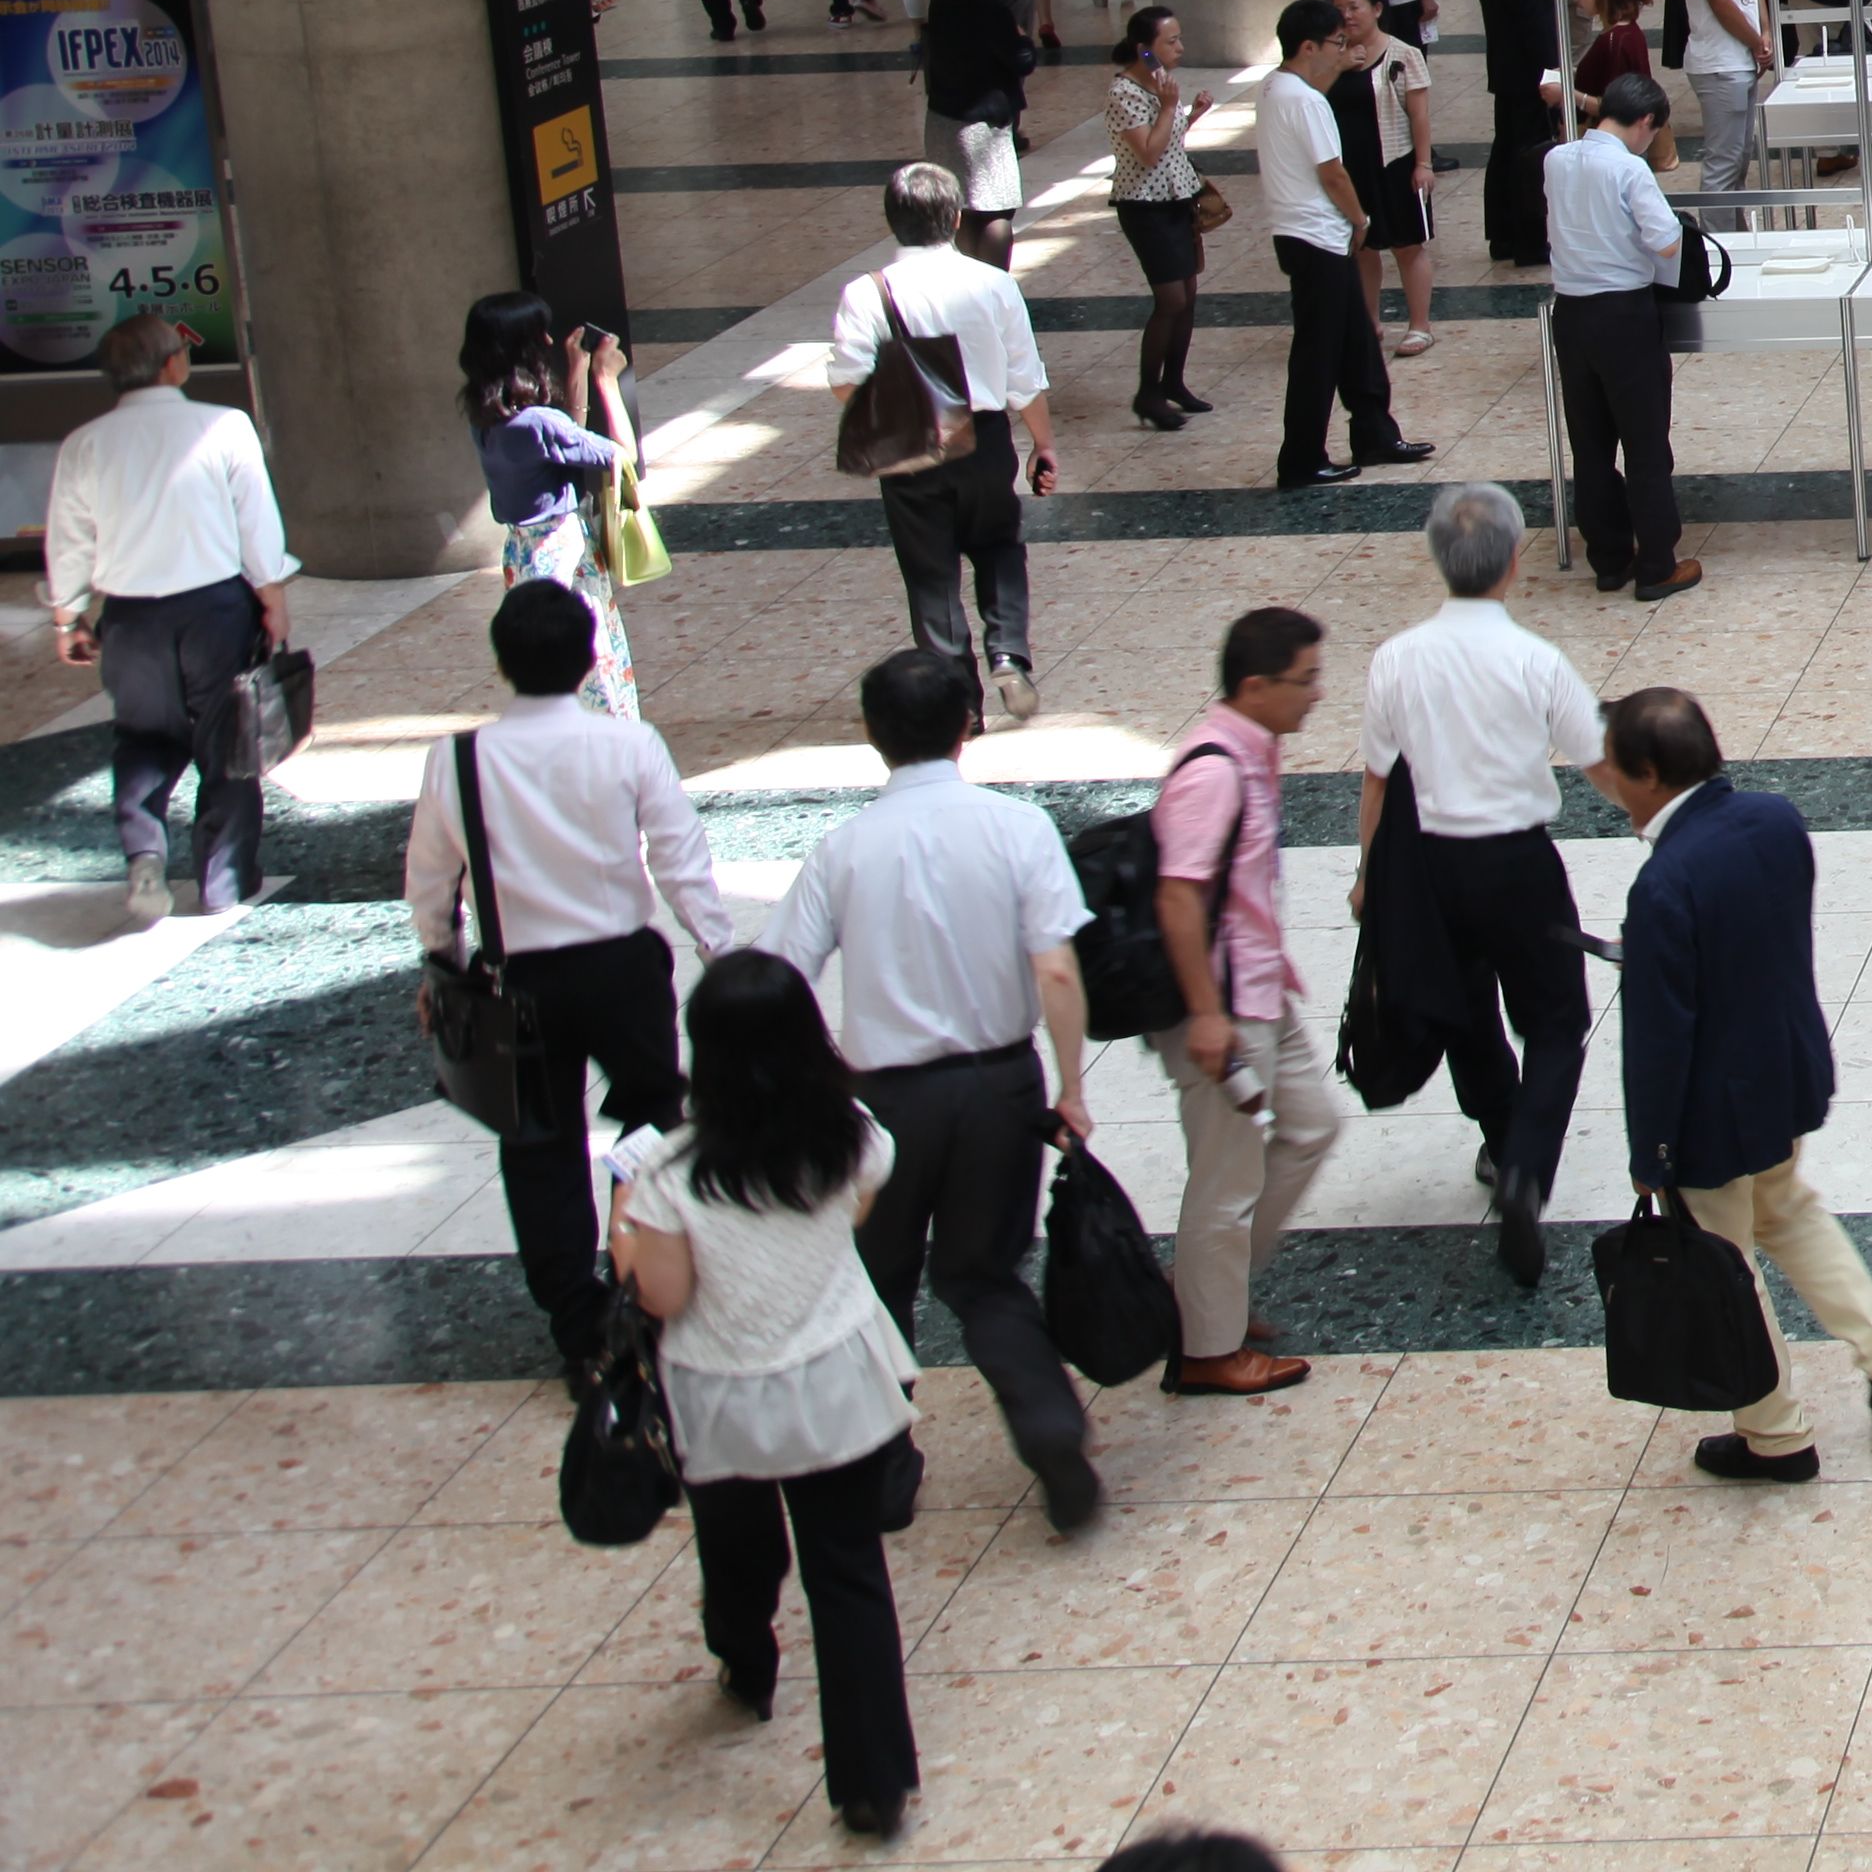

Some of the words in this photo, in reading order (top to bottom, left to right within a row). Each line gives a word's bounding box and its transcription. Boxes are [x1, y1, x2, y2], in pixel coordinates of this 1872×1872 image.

[57, 26, 145, 71] IFPEX
[145, 39, 180, 67] 2014
[35, 120, 134, 141] 計量計測展
[82, 189, 213, 212] 総合検査機器展
[546, 194, 579, 225] 喫煙所
[0, 256, 88, 275] SENSOR
